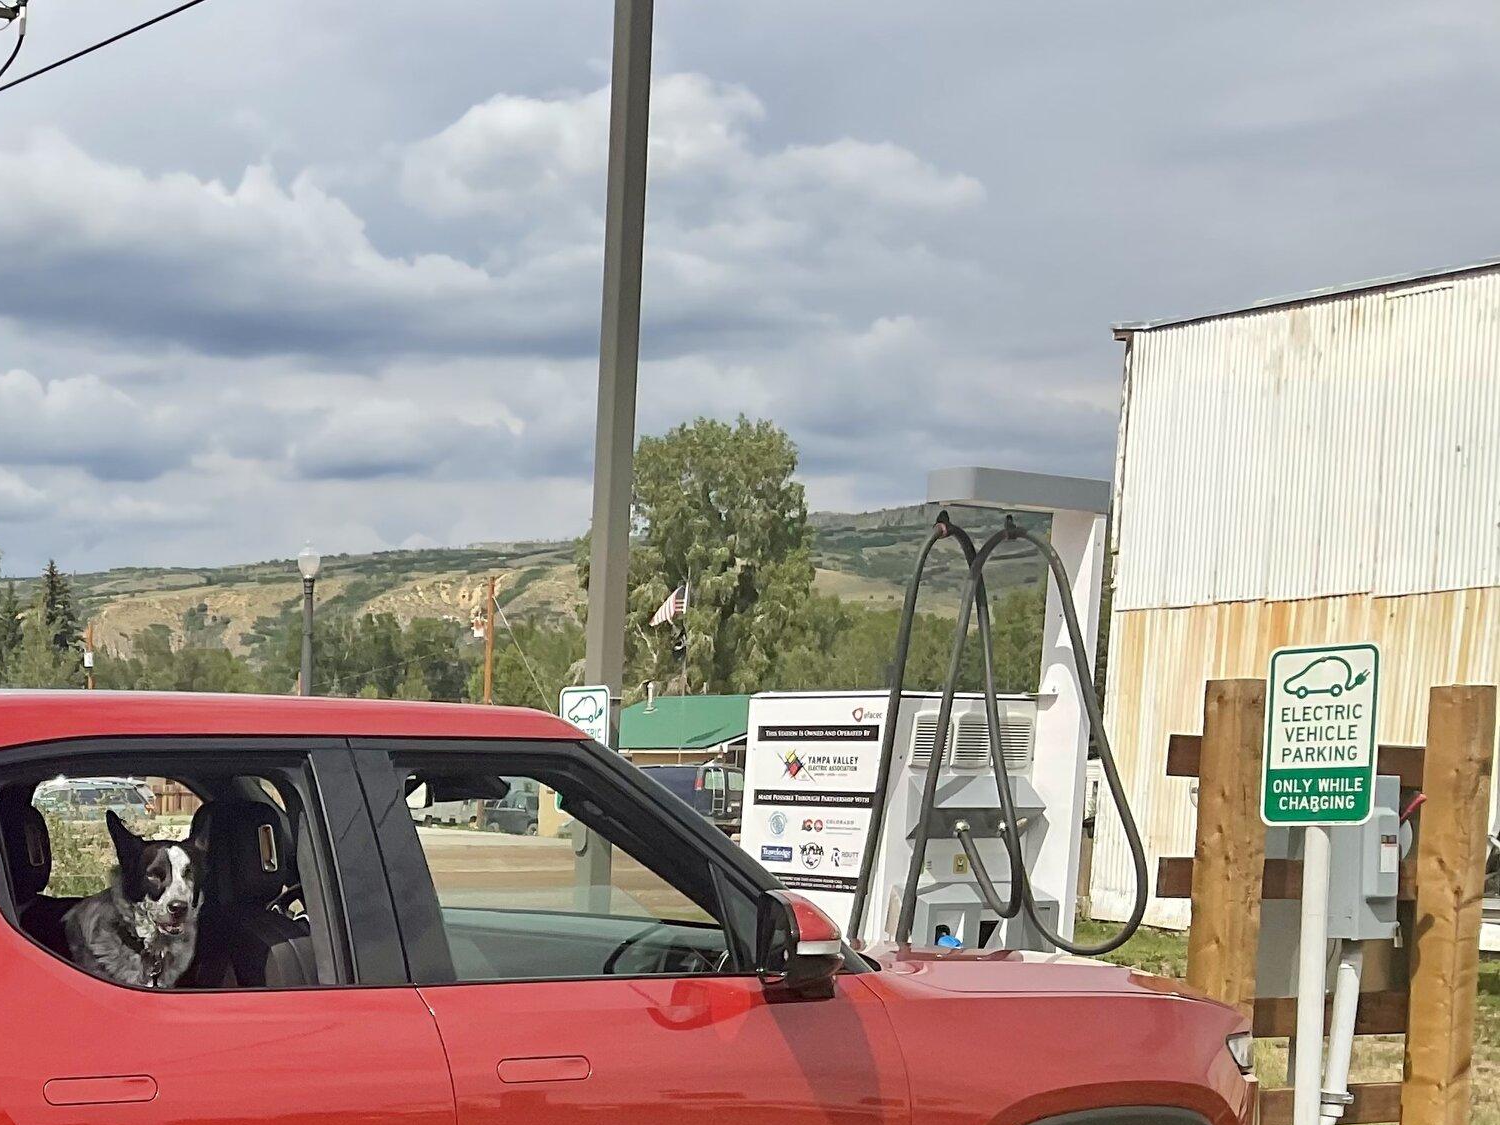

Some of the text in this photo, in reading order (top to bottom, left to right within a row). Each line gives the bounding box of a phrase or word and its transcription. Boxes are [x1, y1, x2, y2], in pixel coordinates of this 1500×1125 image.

[1281, 704, 1363, 722] ELECTRIC
[1284, 725, 1358, 742] VEHICLE
[808, 756, 859, 764] YAMPA VALLEY
[1281, 746, 1358, 763] PARKING
[1273, 778, 1364, 793] ONLY WHILE
[1279, 796, 1355, 811] CHARGING
